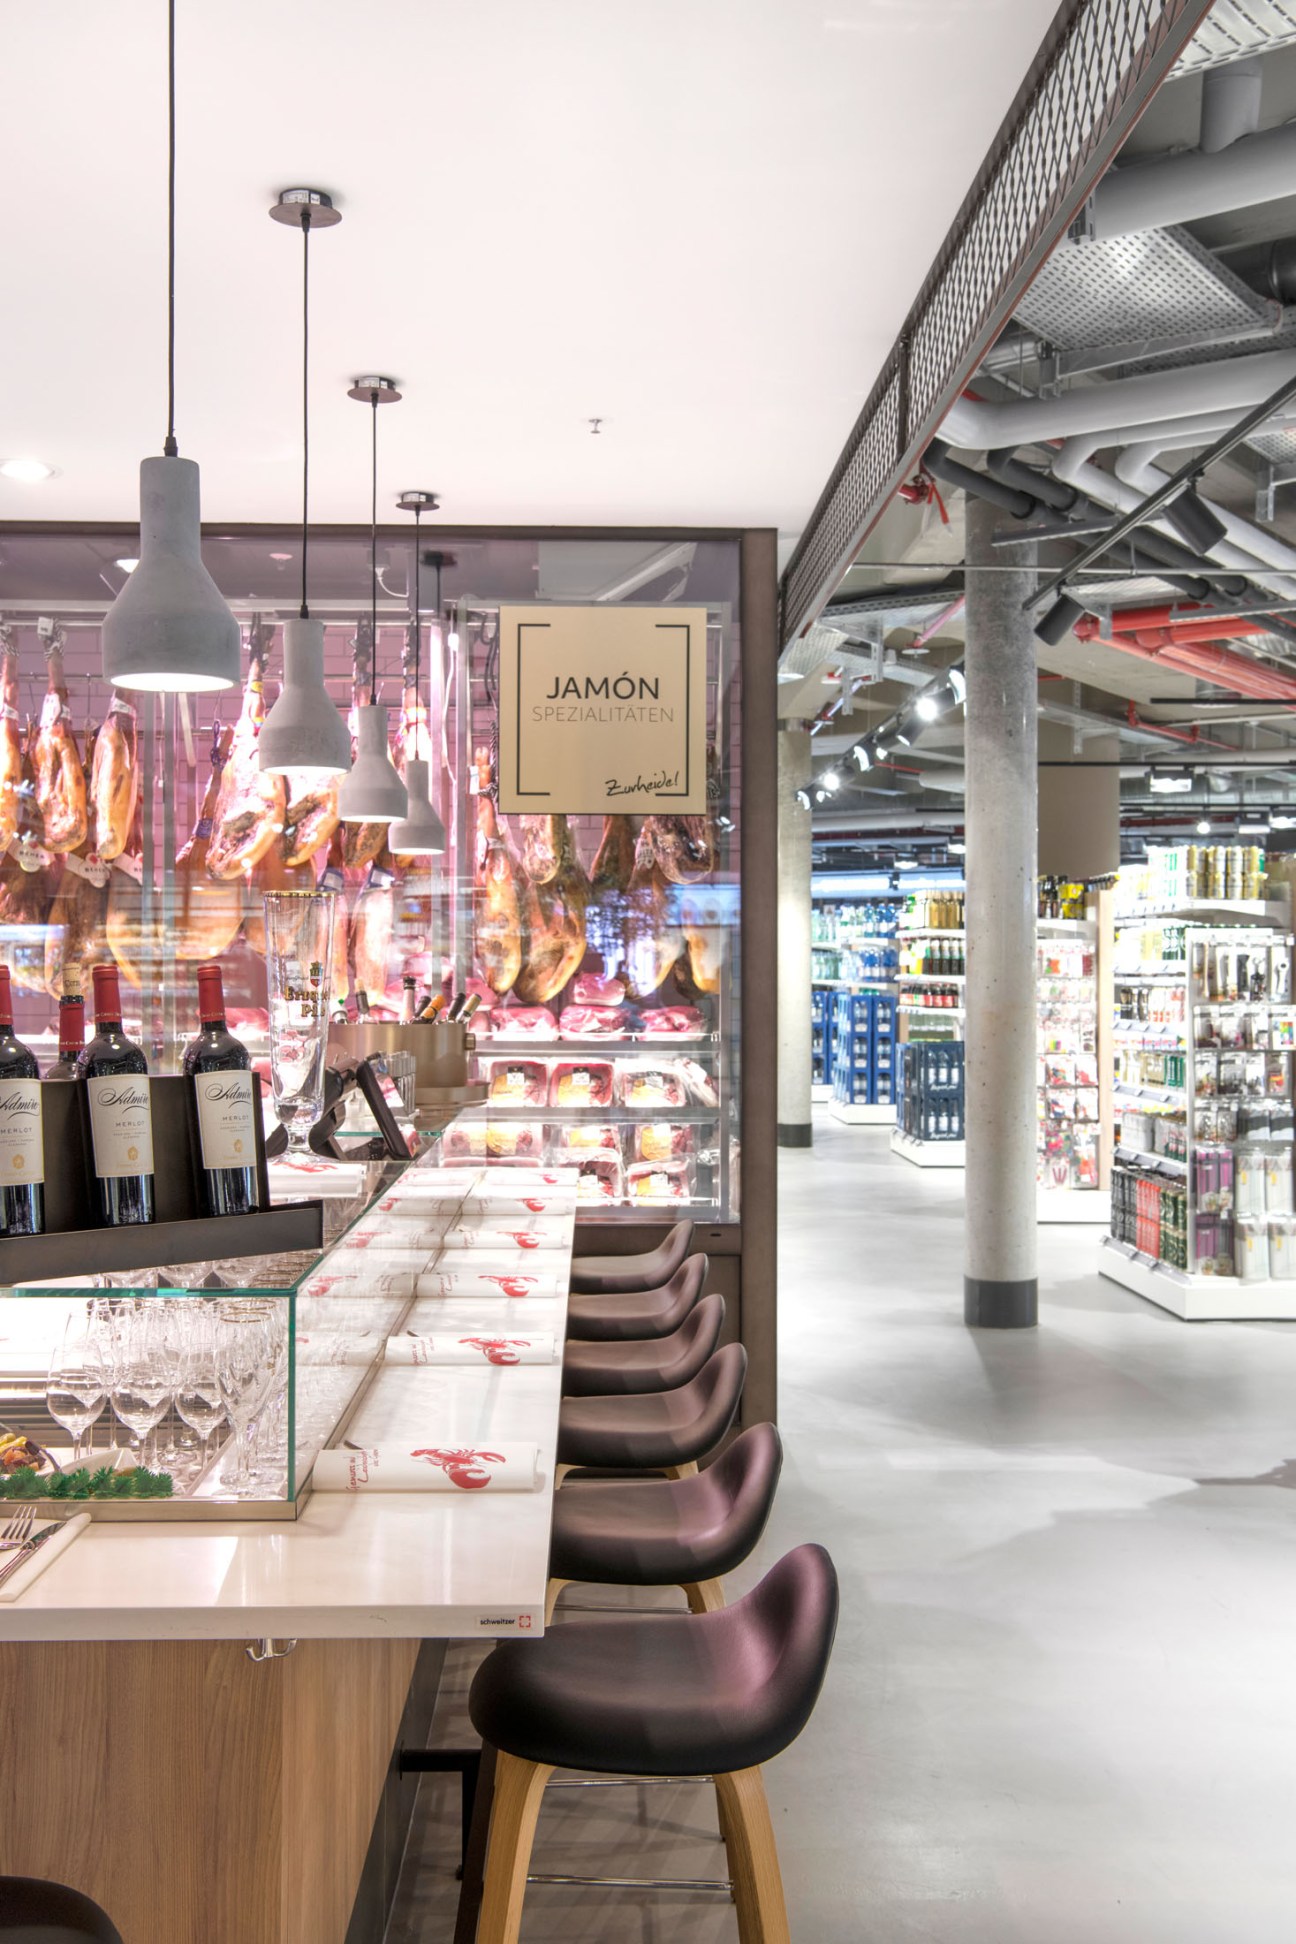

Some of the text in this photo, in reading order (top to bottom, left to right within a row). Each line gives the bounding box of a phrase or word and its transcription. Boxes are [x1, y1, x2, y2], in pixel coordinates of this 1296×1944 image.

[546, 671, 659, 699] JAMÓN
[532, 704, 674, 722] SPEZIALITÄTEN
[605, 770, 679, 796] Zurheide!
